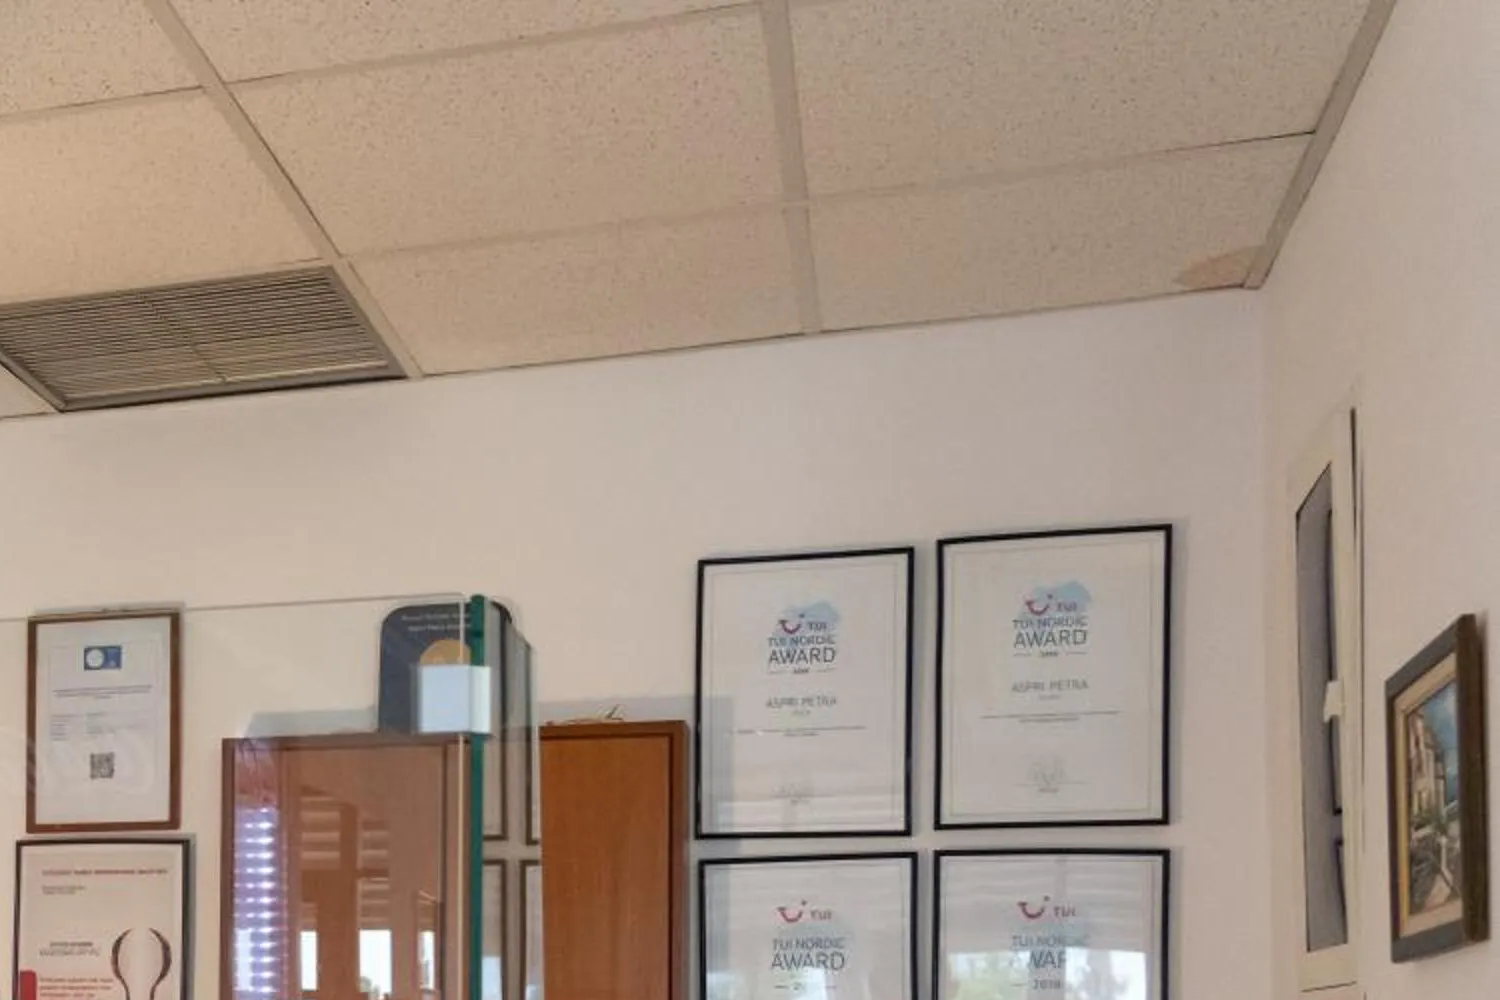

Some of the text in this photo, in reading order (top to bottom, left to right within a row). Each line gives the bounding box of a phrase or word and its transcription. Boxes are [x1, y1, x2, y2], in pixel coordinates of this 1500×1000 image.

[1013, 629, 1087, 648] AWARD
[768, 647, 836, 664] AWARD
[771, 951, 846, 971] AWARD
